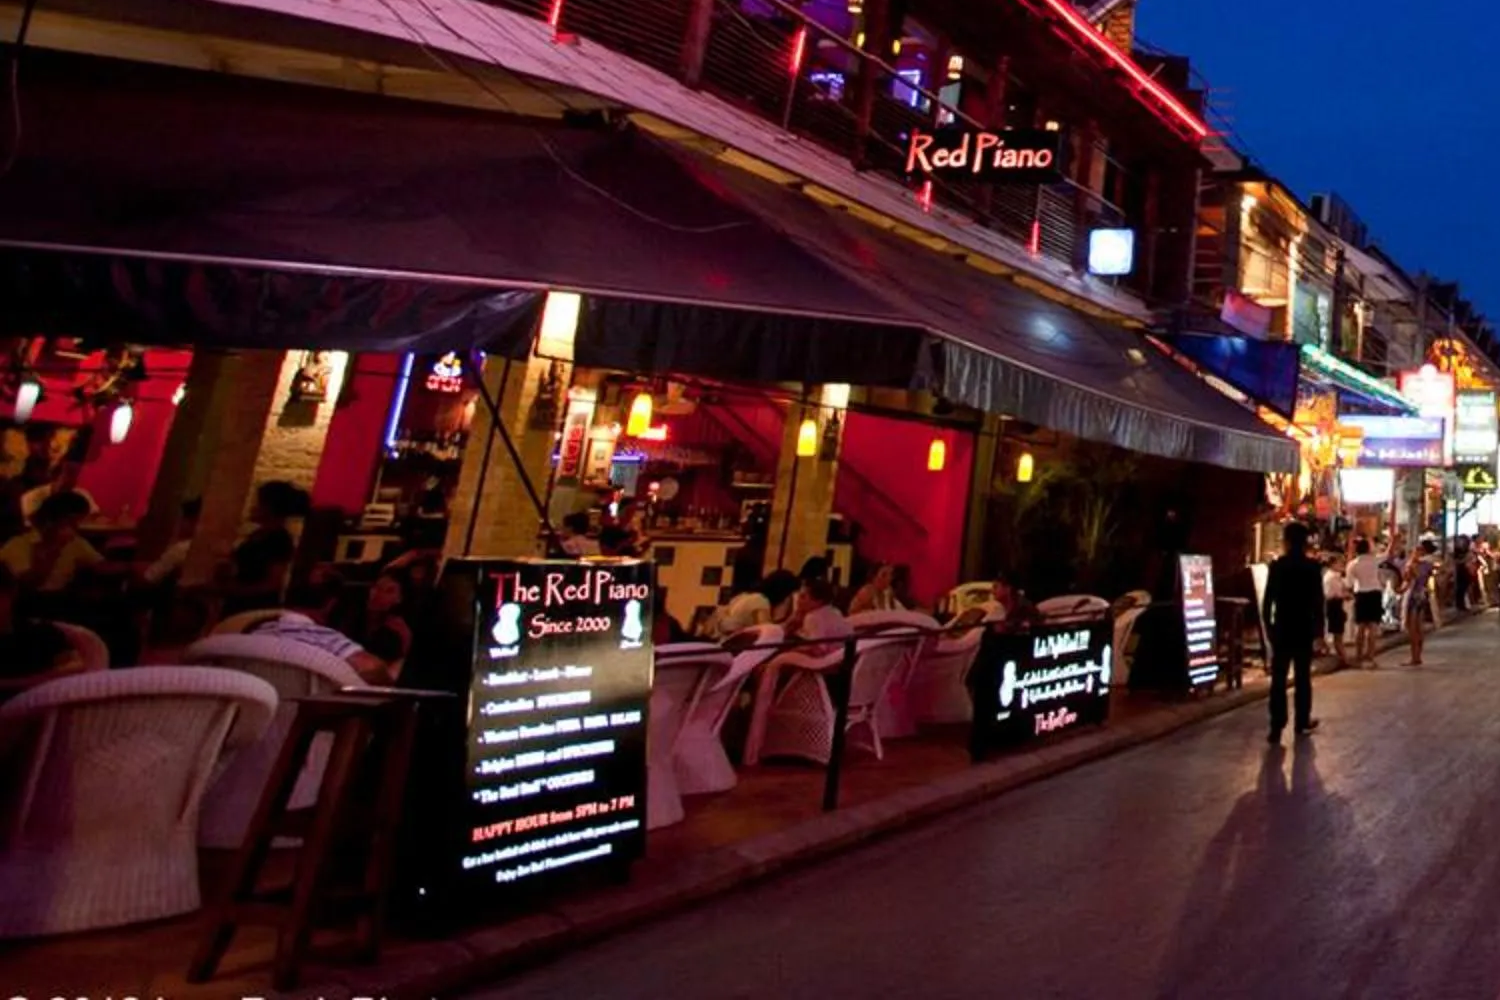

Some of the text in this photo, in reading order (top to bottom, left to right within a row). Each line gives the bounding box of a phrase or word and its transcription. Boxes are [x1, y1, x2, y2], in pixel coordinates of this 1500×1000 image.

[905, 130, 1053, 174] Red Piano
[489, 570, 649, 609] The Red Piano
[528, 612, 611, 639] Since 2000
